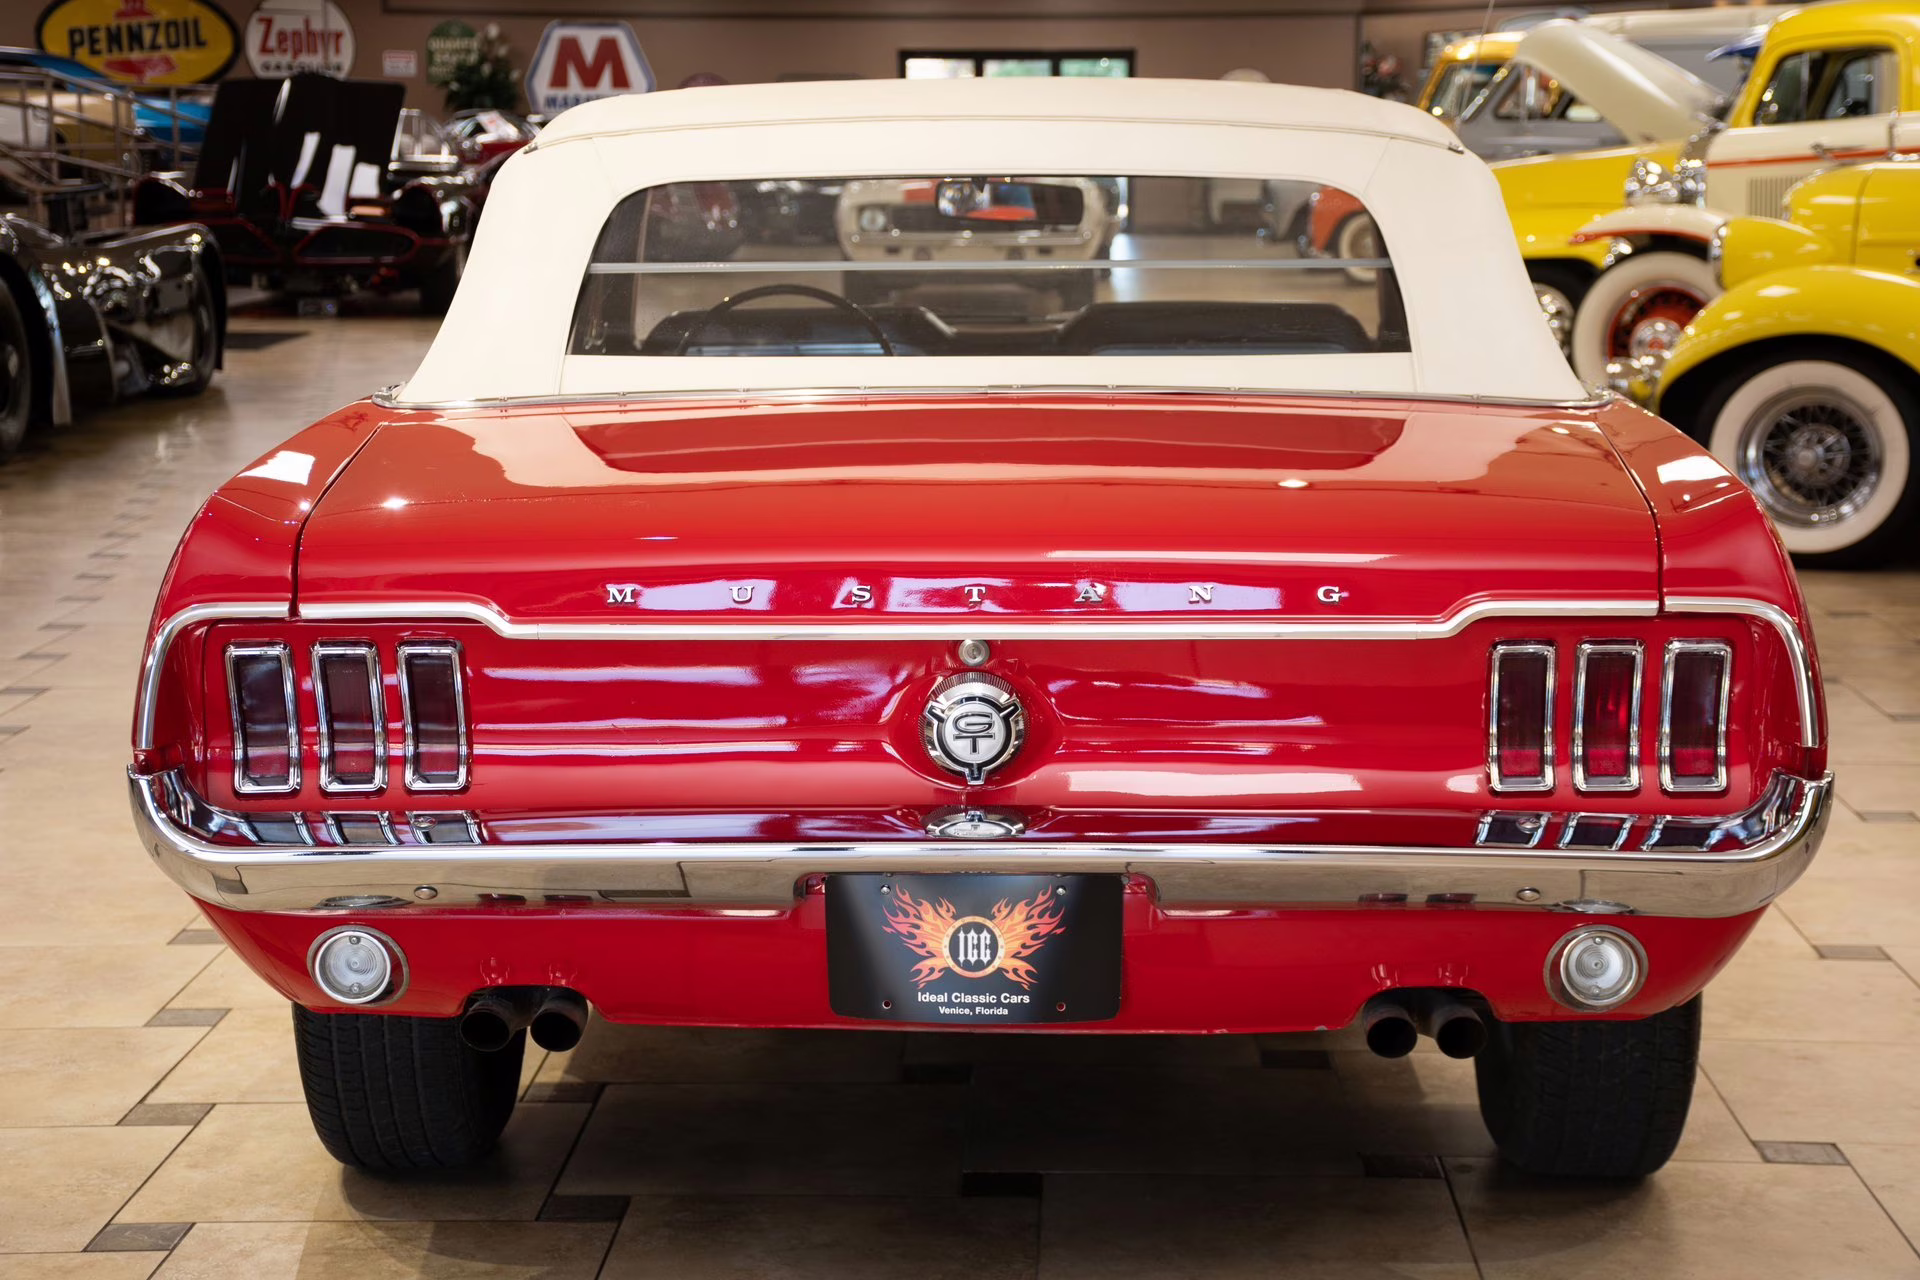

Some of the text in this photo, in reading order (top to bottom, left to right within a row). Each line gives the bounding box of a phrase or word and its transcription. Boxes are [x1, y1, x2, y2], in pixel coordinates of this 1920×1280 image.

[68, 18, 208, 57] PENNZOIL
[257, 15, 344, 60] Zephyr
[547, 36, 632, 90] M
[606, 584, 1342, 605] MUSTANG
[917, 991, 1031, 1004] Ideal Classic Cars
[938, 1006, 1009, 1016] Venice, Florida
